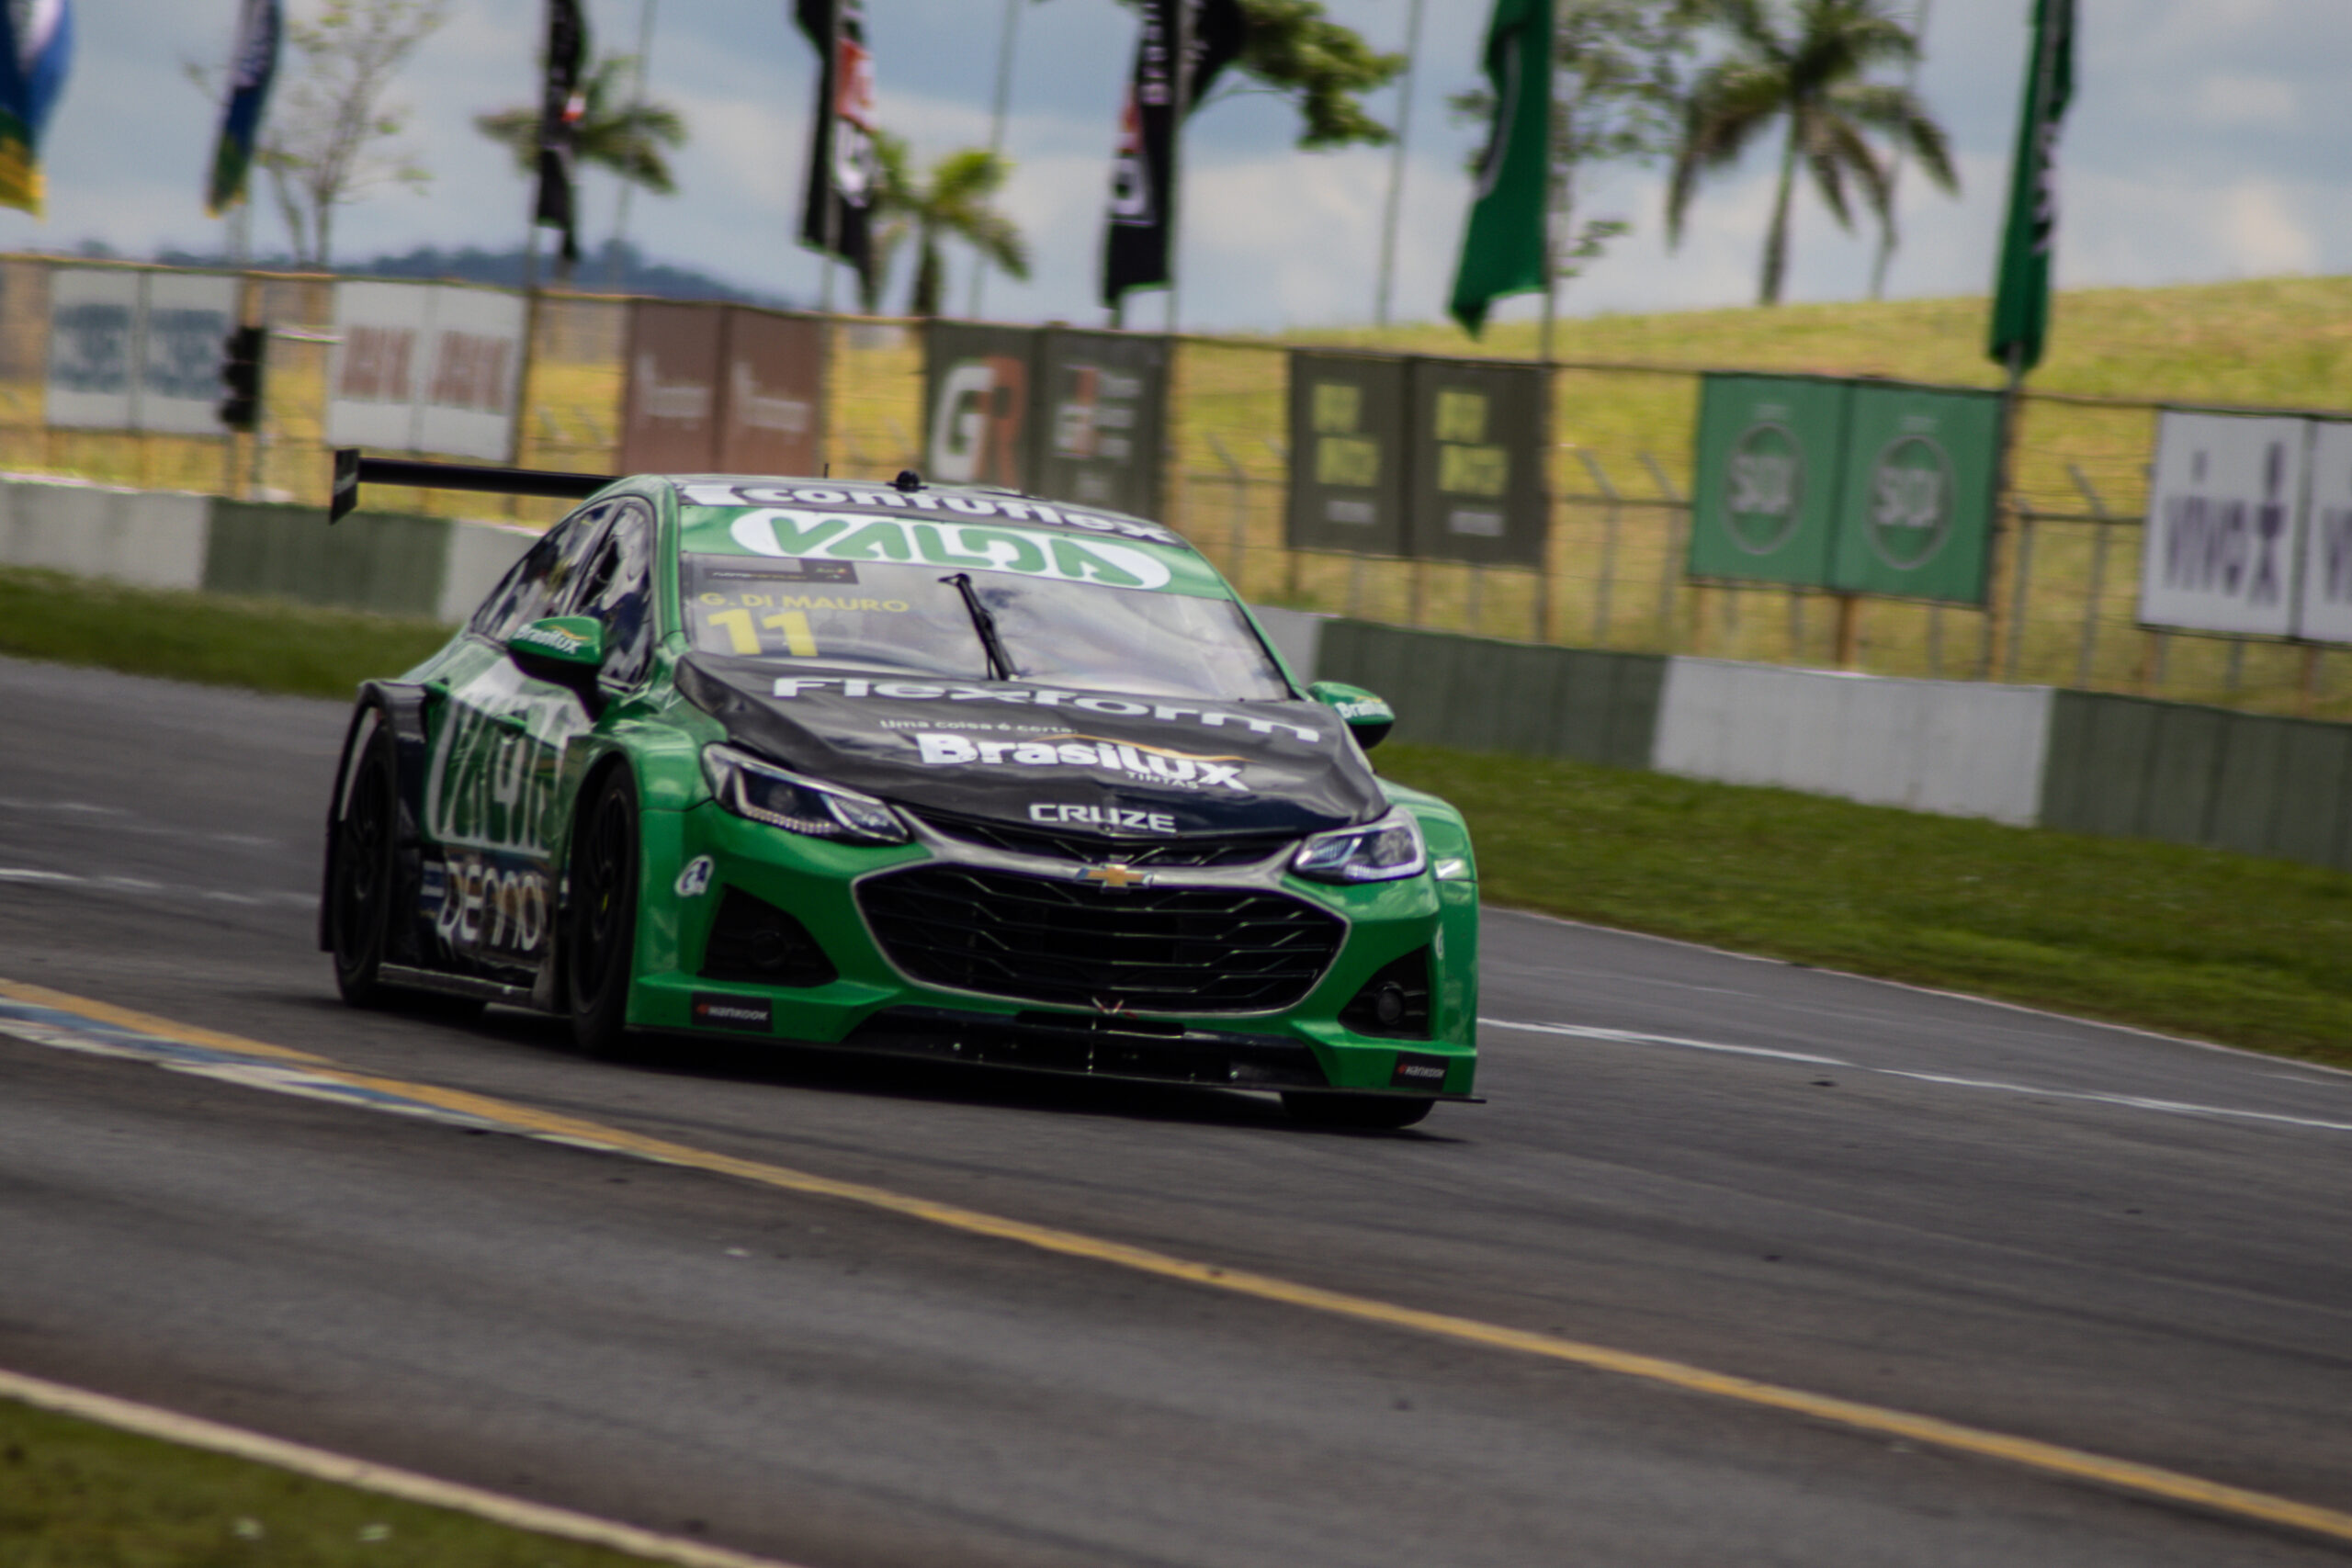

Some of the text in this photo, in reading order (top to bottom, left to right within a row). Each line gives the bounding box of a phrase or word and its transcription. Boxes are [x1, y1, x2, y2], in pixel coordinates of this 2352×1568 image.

[768, 515, 1145, 588] VALDA
[741, 594, 774, 607] DI
[782, 595, 910, 613] MAURO
[707, 608, 819, 657] 11
[774, 677, 1320, 742] Flexform
[916, 734, 1250, 791] Brasilux
[1028, 803, 1177, 833] CRUZE
